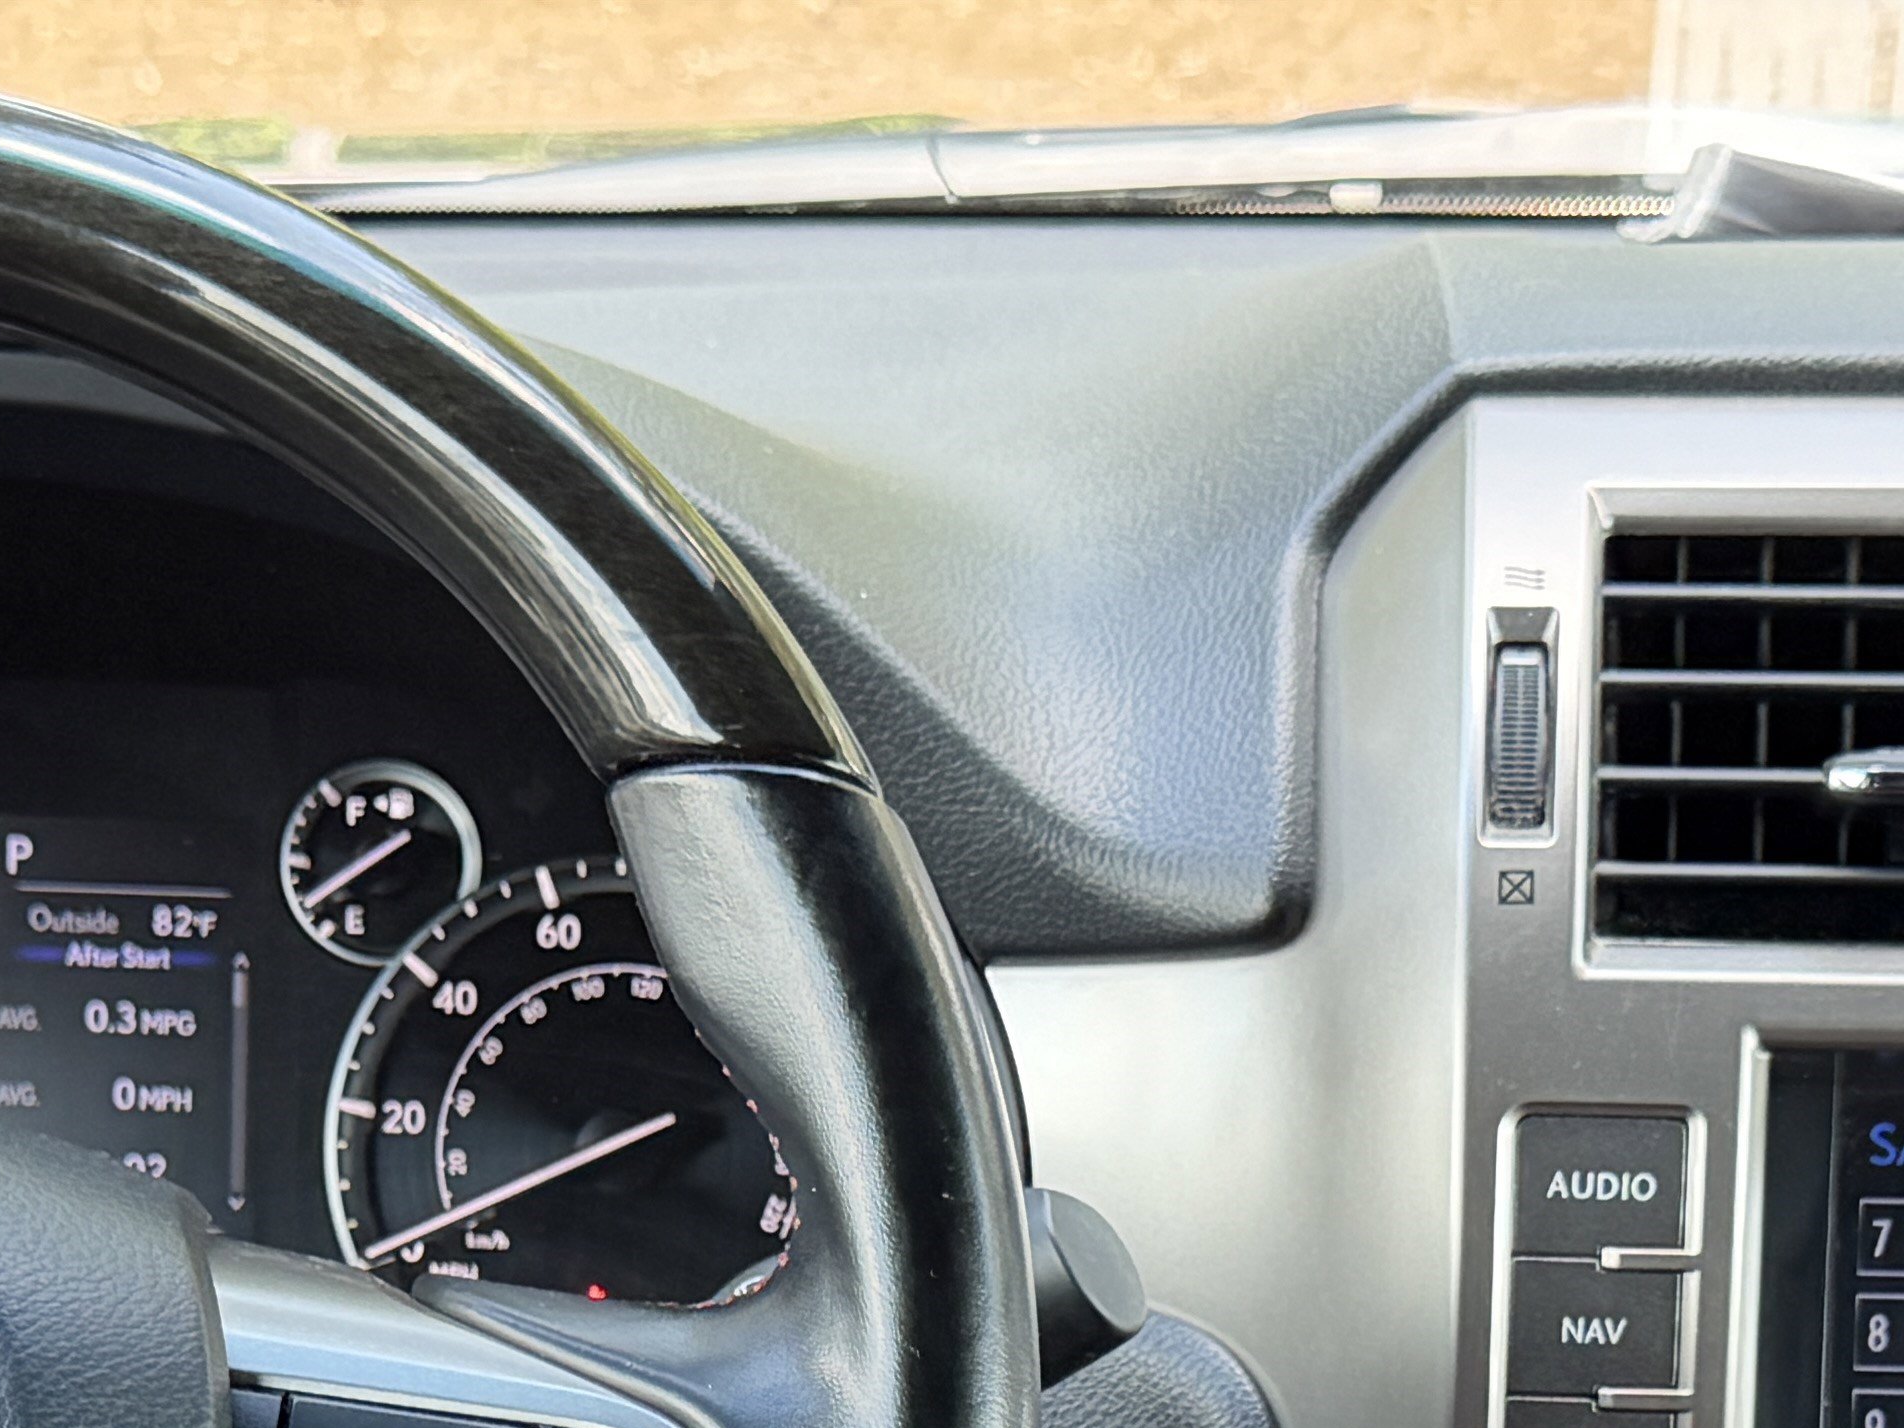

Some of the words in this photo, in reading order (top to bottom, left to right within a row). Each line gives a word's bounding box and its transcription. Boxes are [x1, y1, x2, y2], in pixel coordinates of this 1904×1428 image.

[346, 795, 367, 827] F
[5, 833, 34, 876] P
[26, 902, 120, 935] Outside
[345, 904, 365, 935] E
[536, 914, 582, 951] 60
[432, 980, 478, 1016] 40
[84, 998, 138, 1035] 0.3
[140, 1008, 197, 1037] MPG
[111, 1076, 137, 1112] 0
[138, 1085, 194, 1113] MPH
[381, 1100, 426, 1135] 20
[1546, 1172, 1658, 1202] AUDIO
[1872, 1219, 1893, 1259] 7
[1561, 1317, 1628, 1345] NAV
[1868, 1314, 1890, 1353] 8
